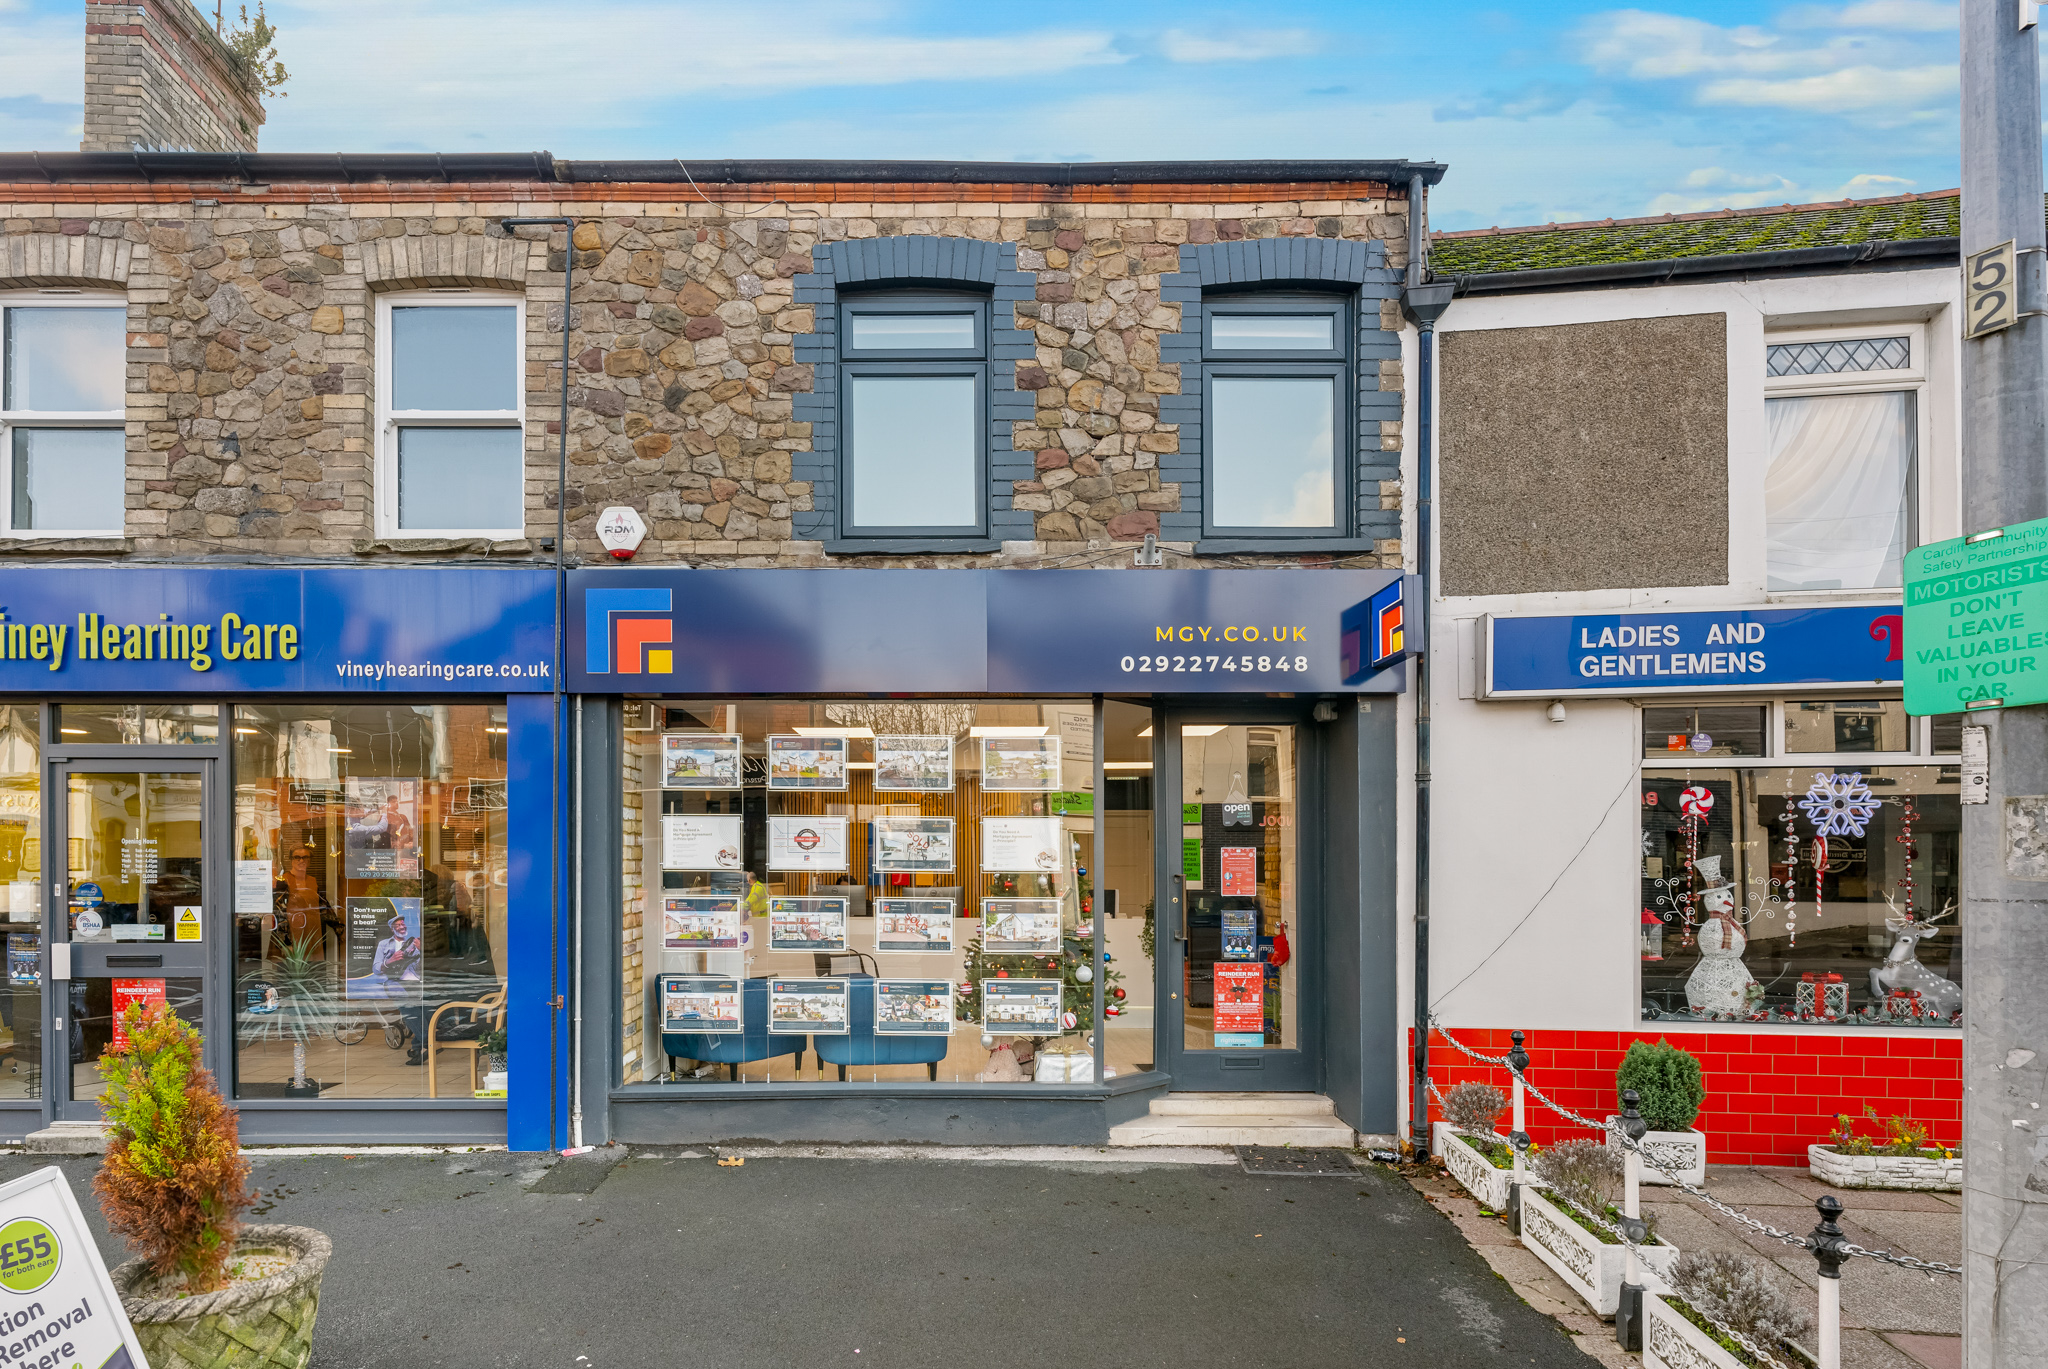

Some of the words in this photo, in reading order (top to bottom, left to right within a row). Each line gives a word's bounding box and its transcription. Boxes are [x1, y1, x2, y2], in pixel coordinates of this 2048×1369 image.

[604, 526, 635, 534] RDM
[1923, 542, 1965, 560] Cardiff
[1923, 557, 1964, 574] Safety
[1968, 541, 2048, 564] Partnership
[1950, 590, 2023, 618] DON'T
[1156, 626, 1307, 642] MGY.CO.UK
[1581, 625, 1680, 648] LADIES
[1705, 622, 1766, 645] AND
[1948, 612, 2024, 639] LEAVE
[79, 613, 212, 671] Hearing
[221, 612, 298, 660] Care
[1916, 632, 2048, 665] VALUABLE
[336, 660, 550, 681] vineyhearingcare.co.uk
[1121, 655, 1309, 672] 02922745848
[1579, 651, 1766, 677] GENTLEMENS
[1938, 666, 1959, 683] IN
[1966, 656, 2037, 679] YOUR
[1957, 682, 2014, 700] CAR.
[1224, 804, 1250, 814] open
[907, 832, 930, 849] SOLD
[904, 913, 928, 930] SOLD
[0, 1233, 52, 1270] £55
[2, 1270, 15, 1279] for
[17, 1262, 36, 1275] both
[37, 1258, 54, 1268] ears
